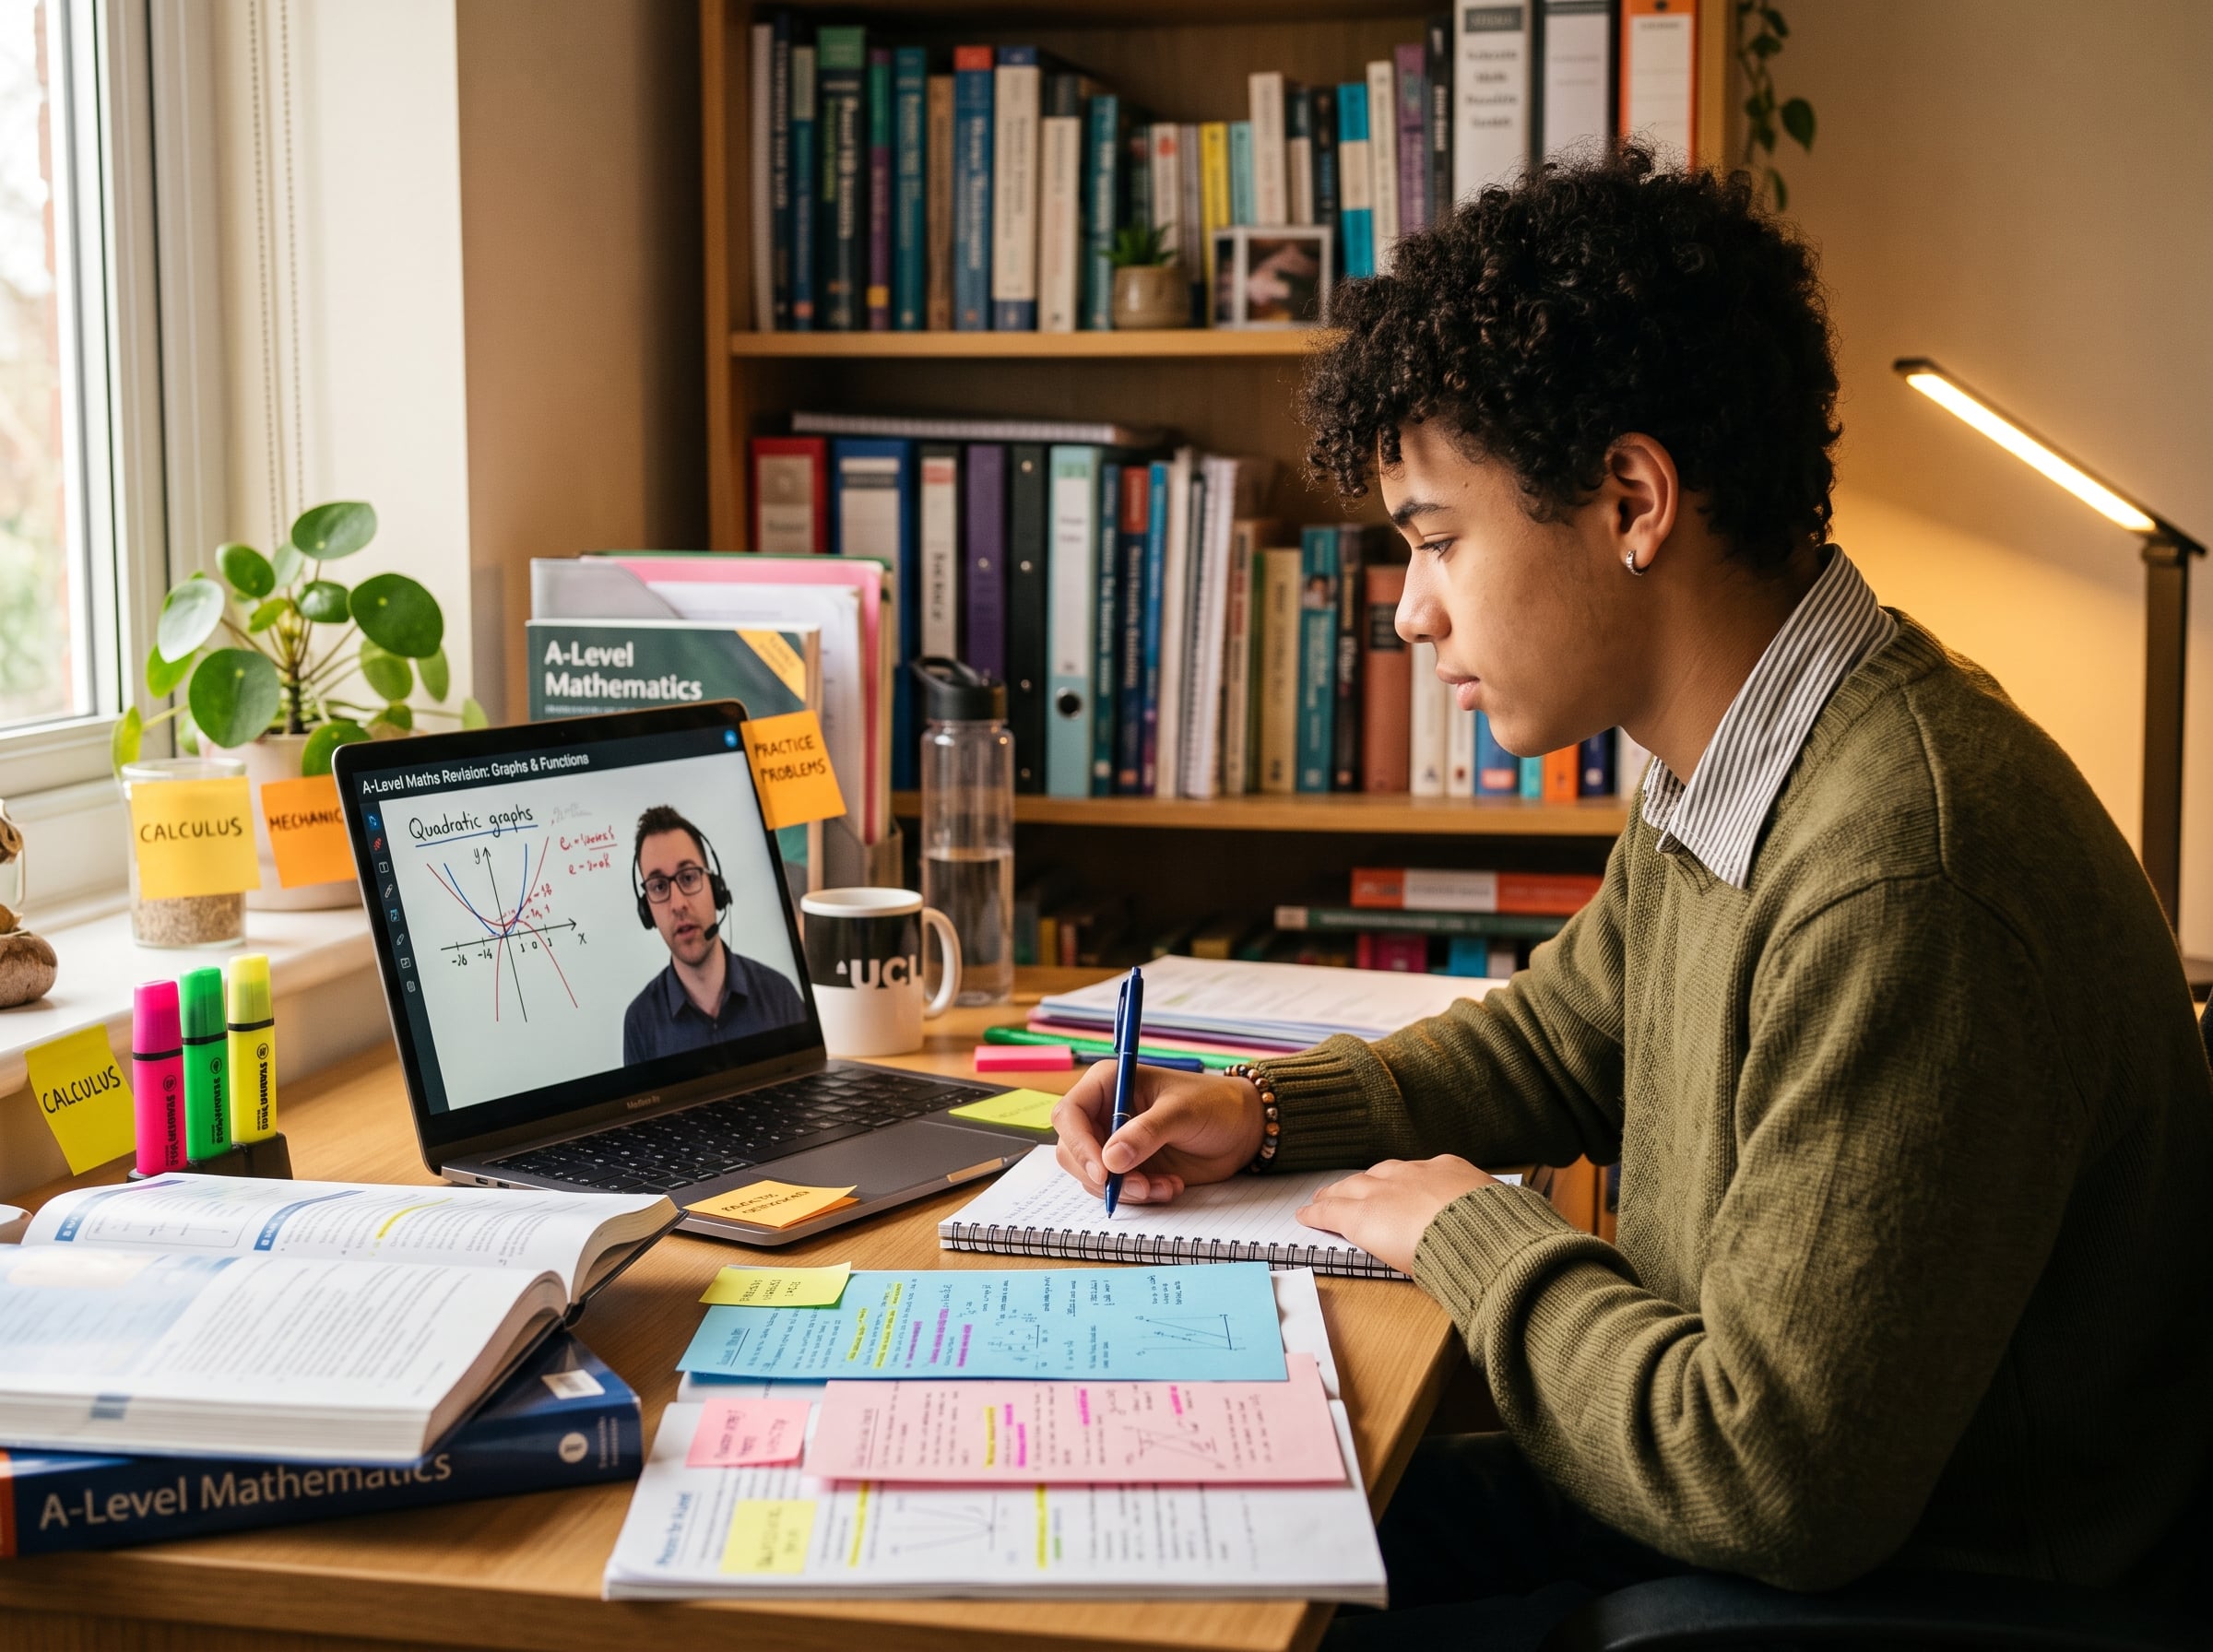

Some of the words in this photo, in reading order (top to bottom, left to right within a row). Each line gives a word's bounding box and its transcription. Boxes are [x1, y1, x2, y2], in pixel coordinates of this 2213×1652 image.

[544, 640, 634, 668] A-Level
[545, 671, 704, 702] Mathematics
[753, 734, 815, 760] PRACTICE
[362, 773, 405, 795] A-Level
[406, 772, 441, 788] Maths
[491, 760, 529, 778] Graphs
[530, 758, 539, 772] &
[539, 752, 590, 771] Functions
[760, 758, 826, 785] PROBLEMS
[140, 817, 243, 844] CALCULUS
[269, 808, 345, 832] MECHANIC
[408, 812, 482, 840] Quadratic
[489, 804, 534, 838] graphs
[42, 1065, 121, 1114] CALCULUS
[39, 1475, 188, 1530] A-Level
